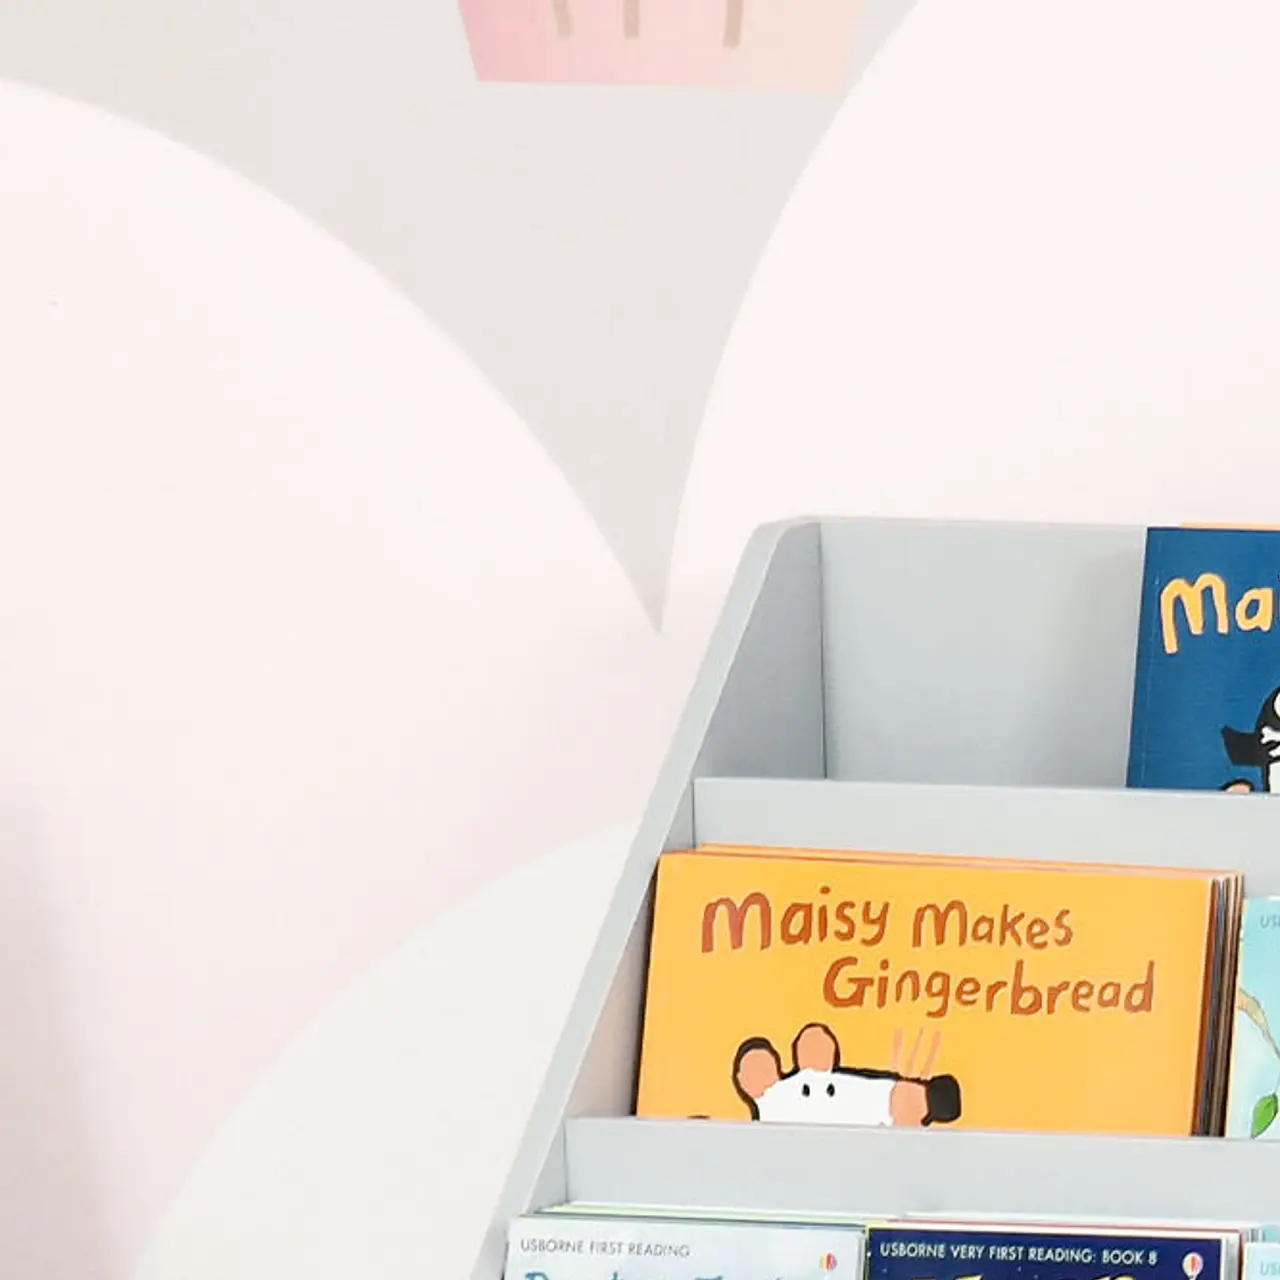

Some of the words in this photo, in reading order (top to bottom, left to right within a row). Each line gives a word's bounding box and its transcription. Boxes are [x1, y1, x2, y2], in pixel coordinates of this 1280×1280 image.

[700, 885, 891, 954] Maisy
[911, 899, 1074, 951] Makes
[821, 954, 1156, 1020] Gingerbread
[520, 1238, 584, 1254] USBORNE
[590, 1240, 623, 1255] FIRST
[628, 1242, 690, 1258] READING
[880, 1242, 945, 1259] USBORNE
[950, 1245, 984, 1260] VERY
[989, 1246, 1024, 1261] FIRST
[1028, 1247, 1096, 1263] READING:
[1102, 1250, 1143, 1265] BOOK
[1147, 1251, 1158, 1265] 8
